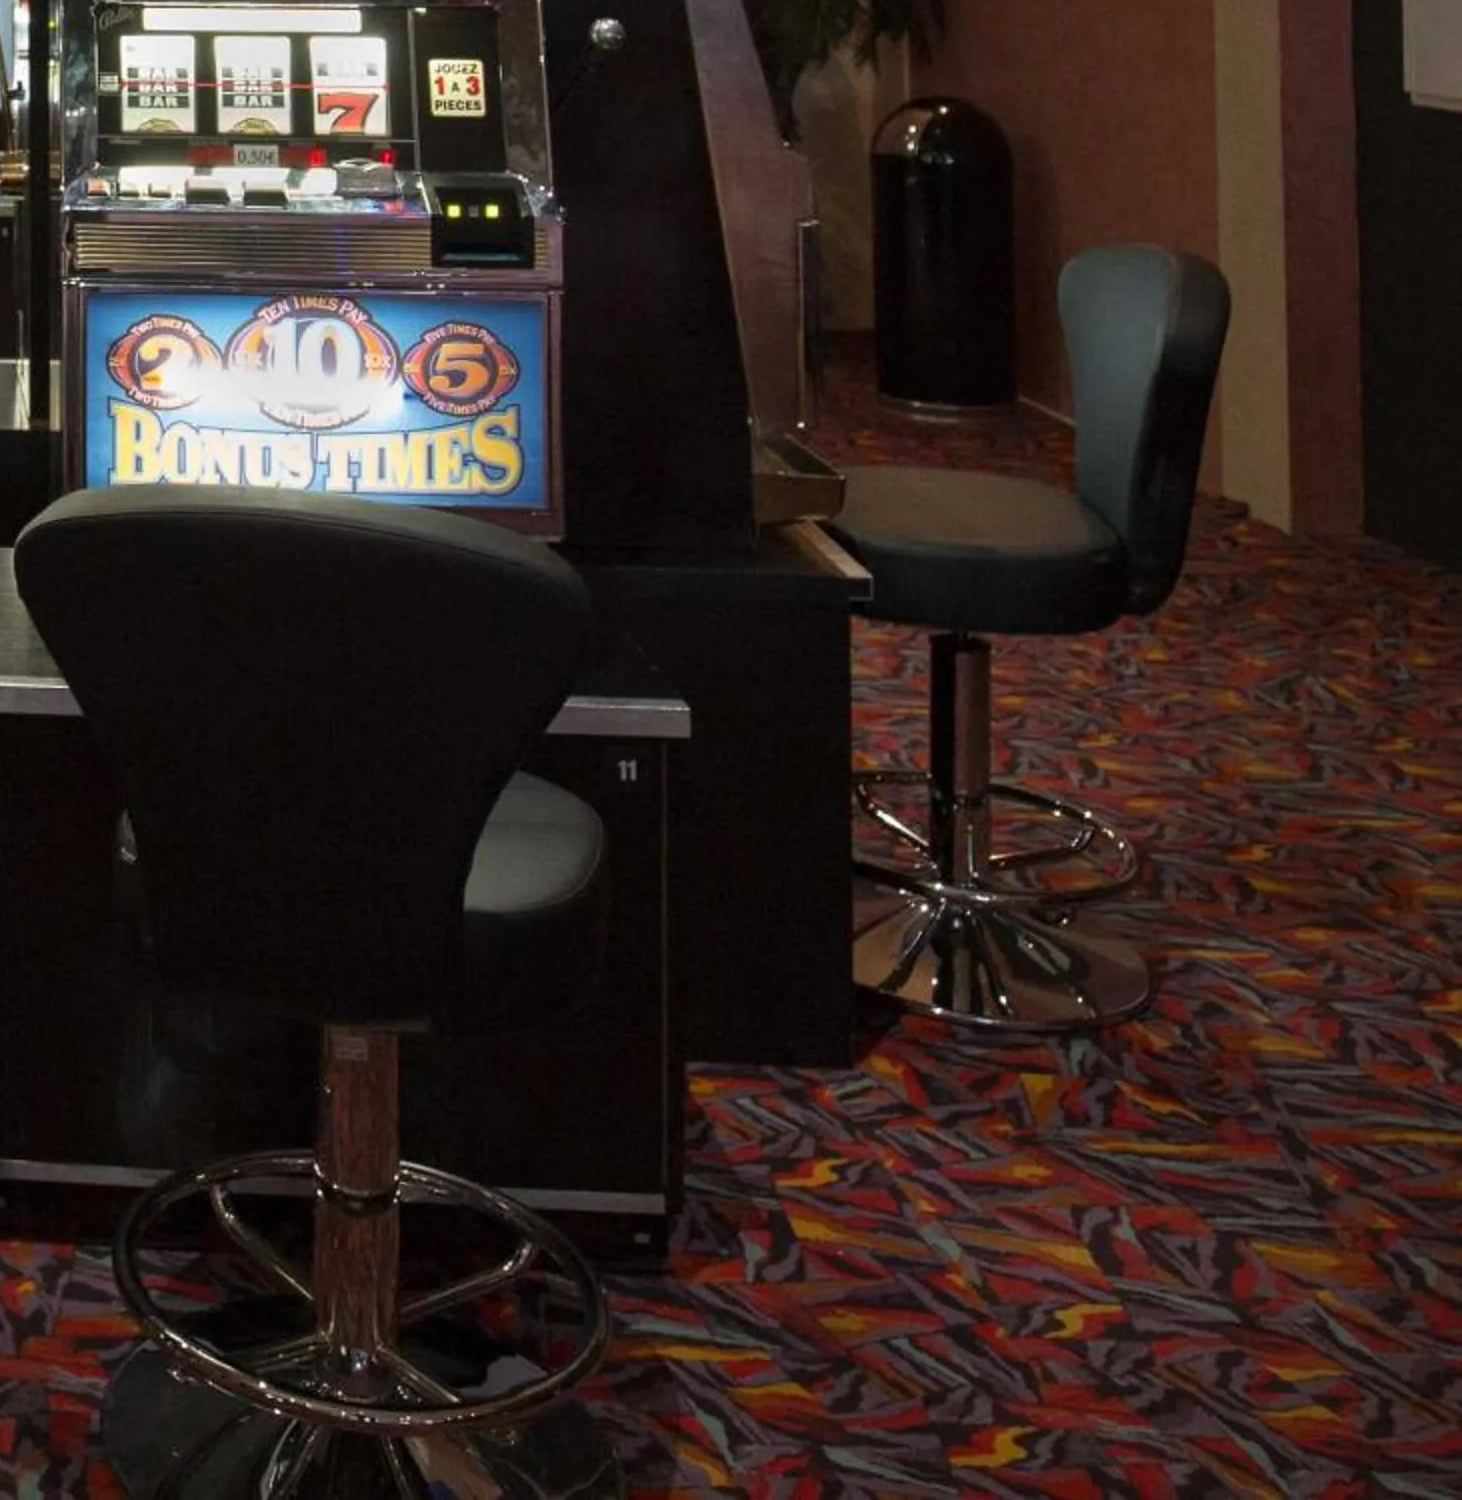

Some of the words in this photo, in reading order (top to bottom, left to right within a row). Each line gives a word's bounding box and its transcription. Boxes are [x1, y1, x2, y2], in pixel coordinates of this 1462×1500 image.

[434, 63, 479, 75] JOUEZ
[434, 76, 445, 96] 1
[451, 81, 461, 92] A
[466, 75, 481, 96] 3
[139, 97, 179, 108] BAR
[234, 97, 274, 108] BAR
[317, 92, 379, 133] 7
[435, 99, 482, 111] PIECES
[258, 301, 291, 324] TEN
[293, 296, 339, 311] TIMES
[339, 301, 368, 325] PAY
[264, 317, 362, 385] 10
[429, 342, 490, 395] 5
[110, 399, 314, 488] BONUS
[318, 405, 523, 493] TIMES
[617, 759, 637, 781] 11
